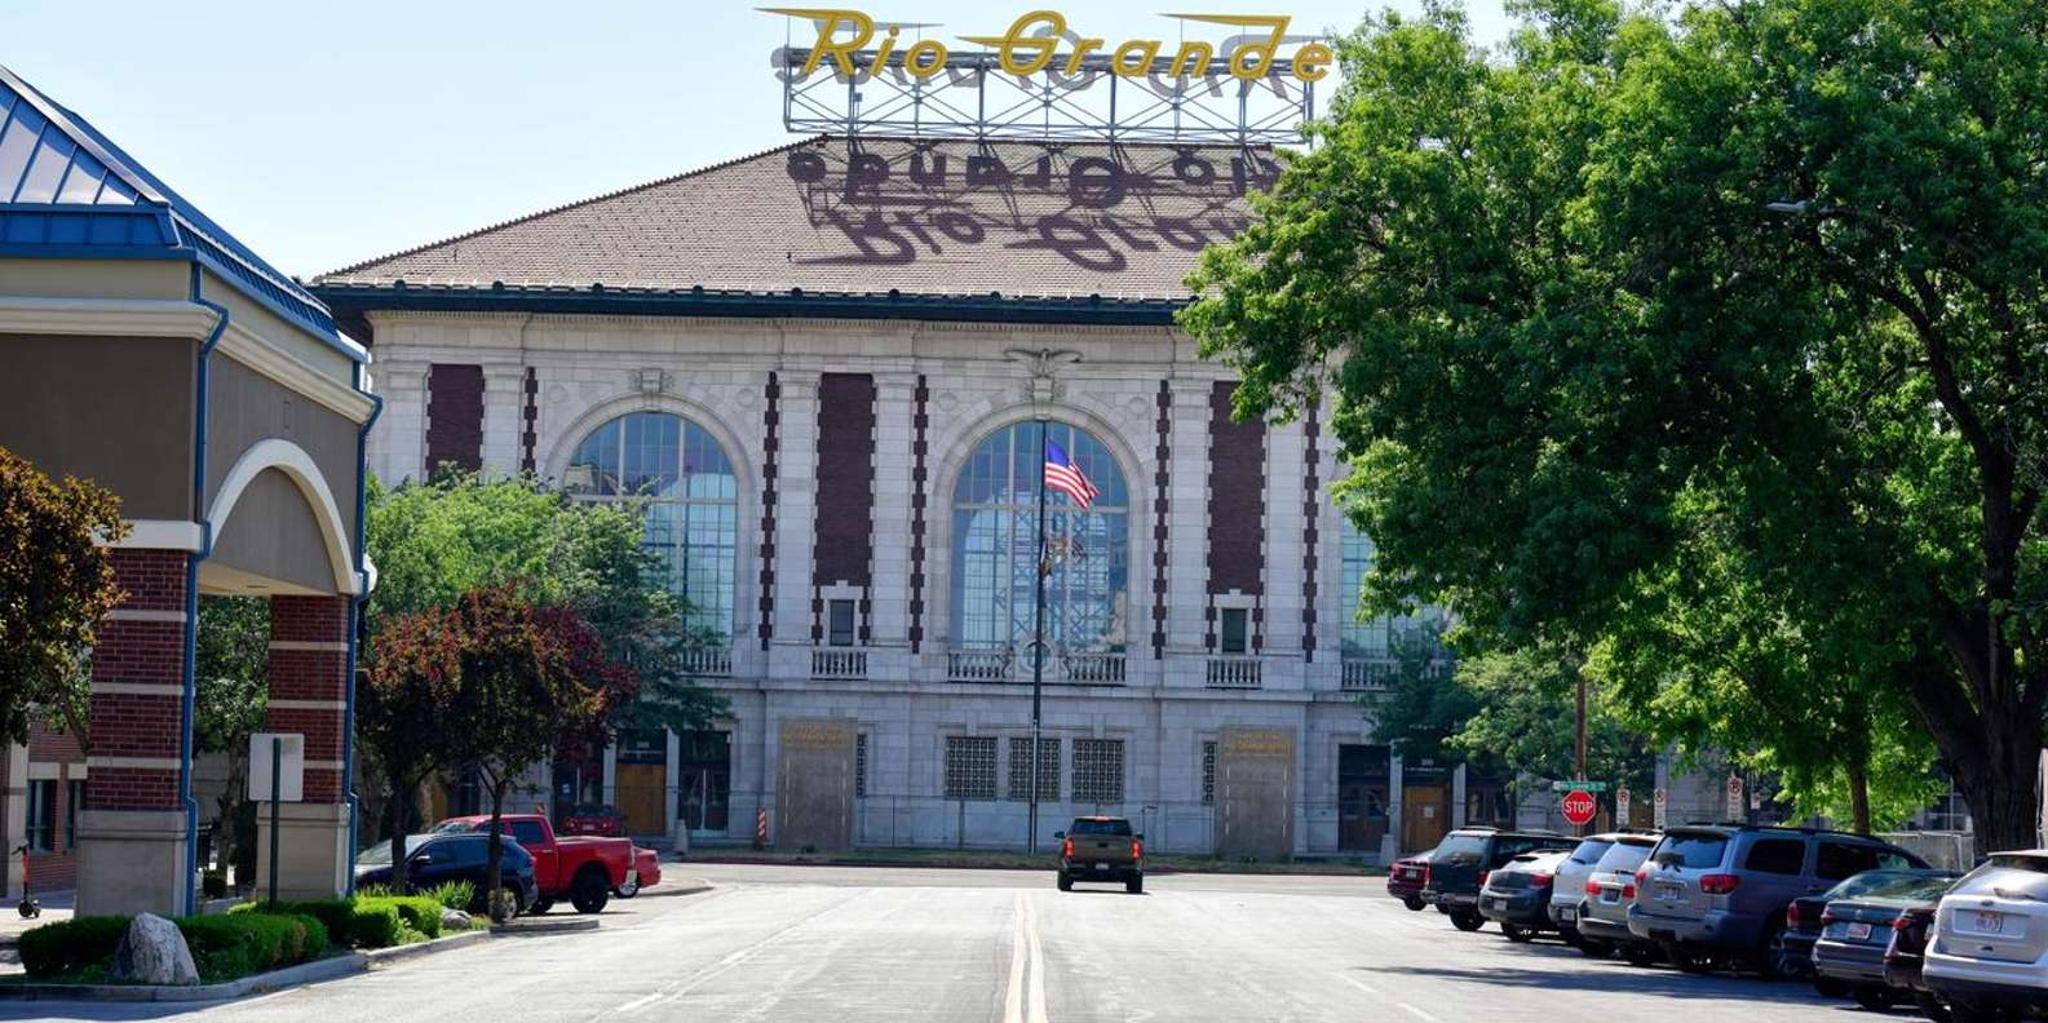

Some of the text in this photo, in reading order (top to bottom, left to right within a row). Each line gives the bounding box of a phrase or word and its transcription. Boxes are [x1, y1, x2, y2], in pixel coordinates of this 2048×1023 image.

[754, 7, 1334, 82] Rio Grande
[1565, 800, 1593, 814] STOP
